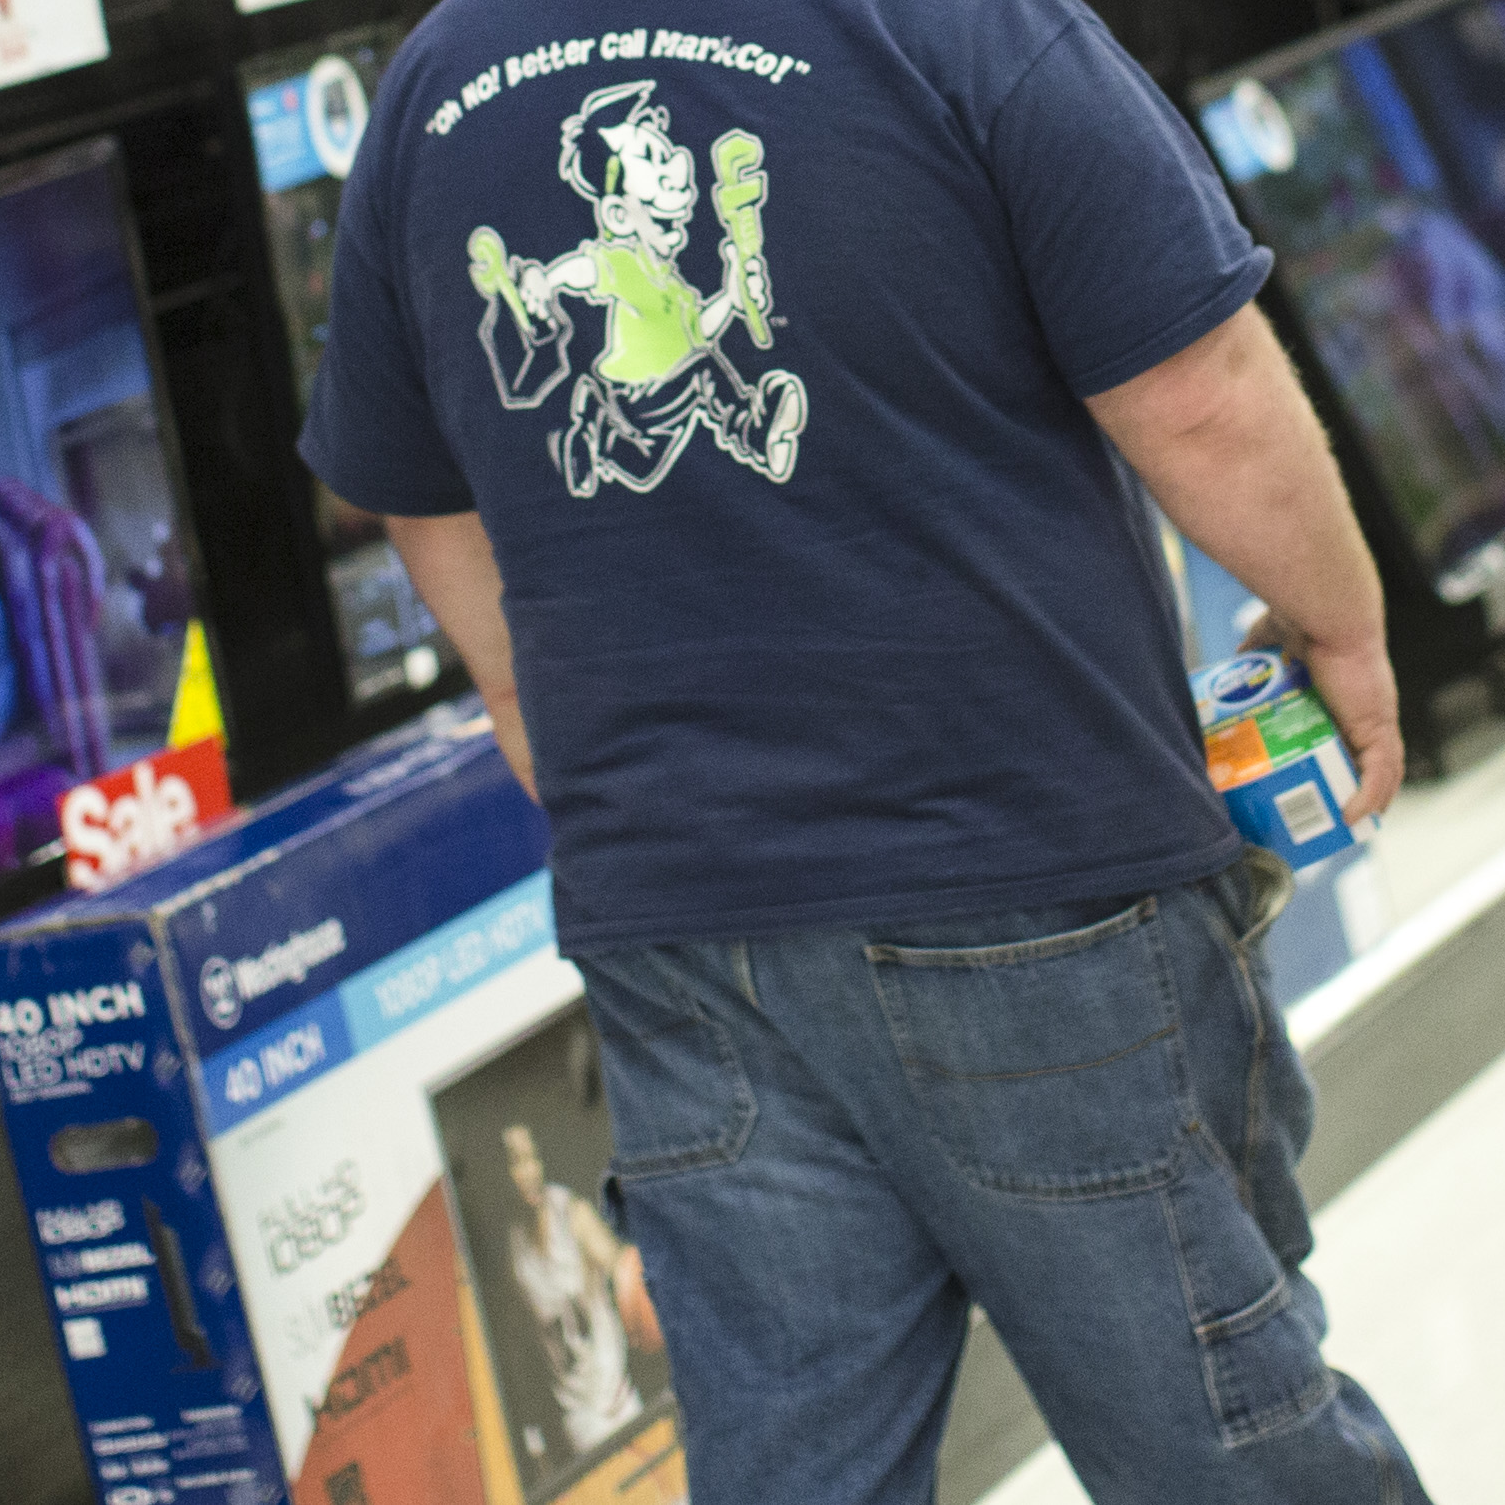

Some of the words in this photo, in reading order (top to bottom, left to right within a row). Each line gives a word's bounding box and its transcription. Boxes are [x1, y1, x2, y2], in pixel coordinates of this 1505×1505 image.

[505, 36, 596, 89] Better
[62, 759, 198, 894] Sale
[47, 981, 146, 1026] INCH
[2, 1056, 64, 1090] LED
[63, 1041, 145, 1079] HDTV
[225, 1058, 263, 1103] 40
[259, 1021, 327, 1089] INCH
